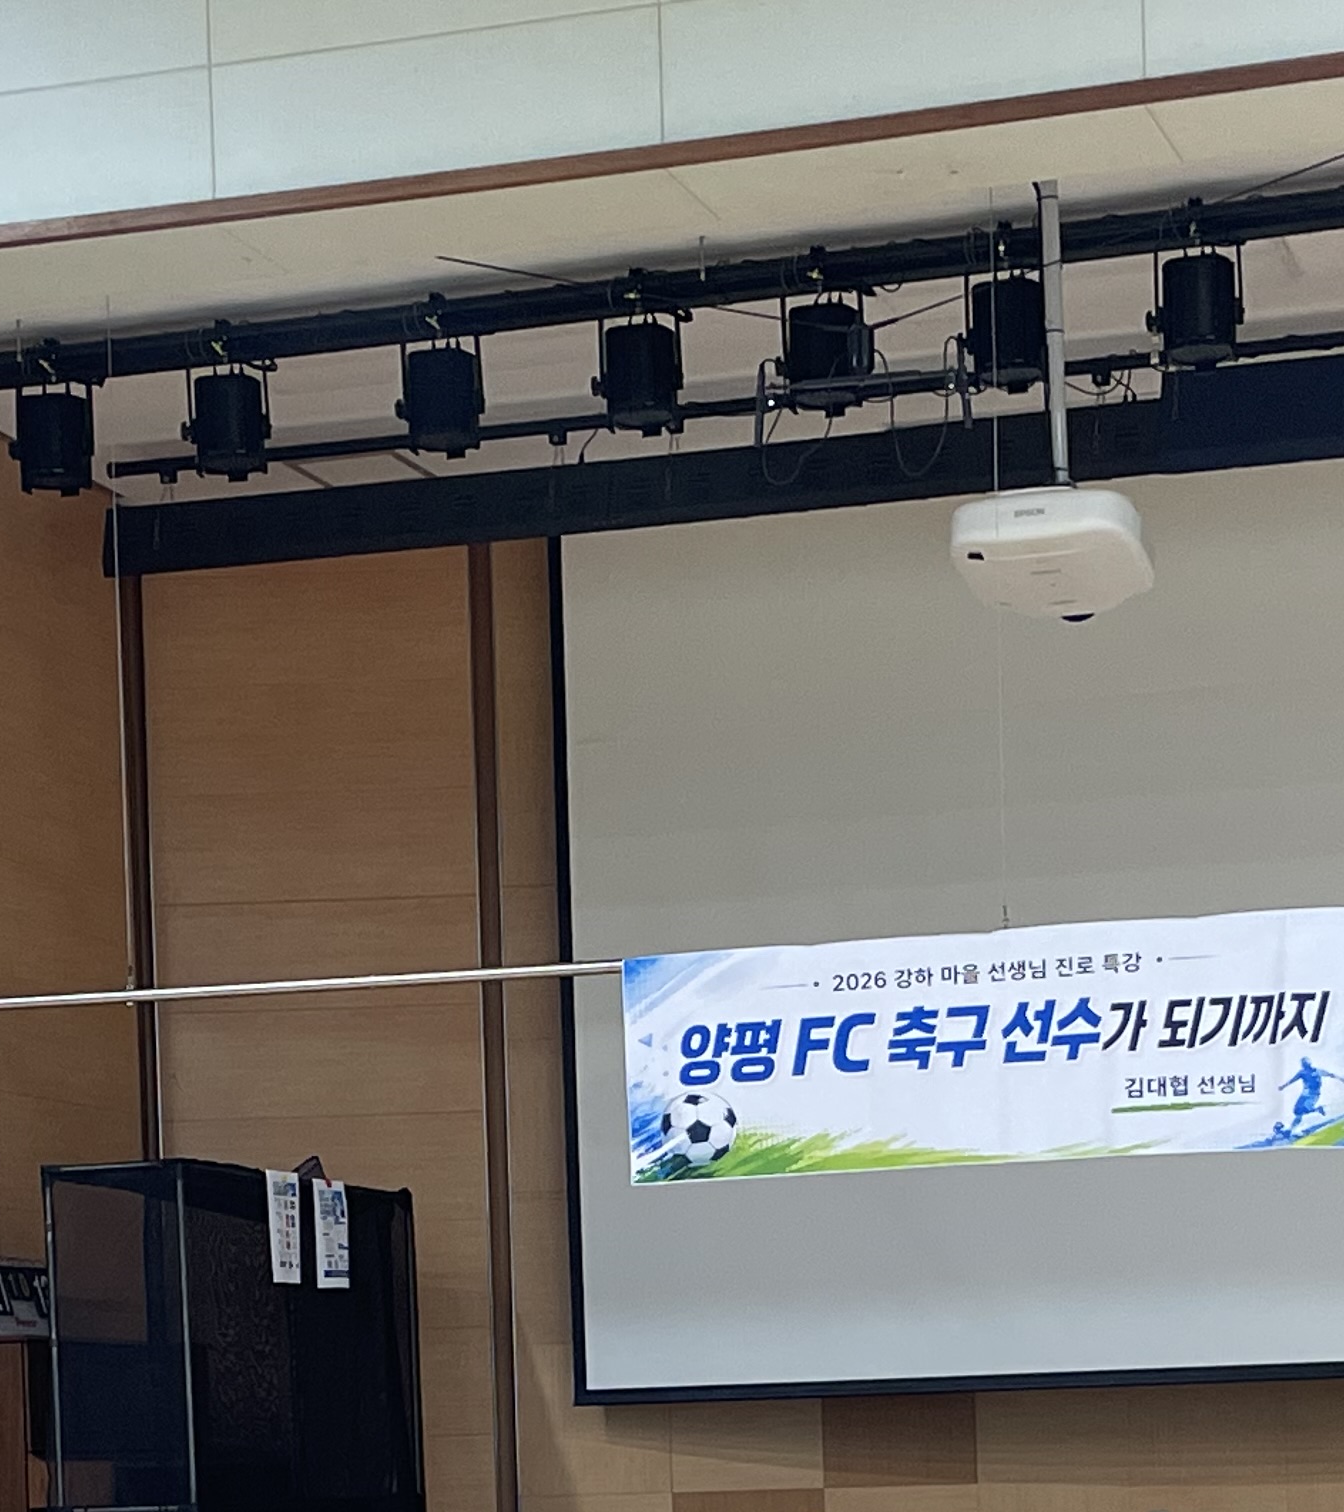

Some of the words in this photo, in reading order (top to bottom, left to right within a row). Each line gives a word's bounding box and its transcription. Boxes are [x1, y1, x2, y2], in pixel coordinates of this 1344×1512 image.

[832, 970, 887, 992] 2026
[893, 967, 933, 989] 강하
[940, 963, 981, 985] 마을
[987, 960, 1047, 982] 선생님
[1054, 955, 1095, 978] 진로
[1102, 952, 1142, 974] 특강
[679, 1018, 782, 1086] 양평
[791, 1012, 876, 1077] FC
[887, 1005, 991, 1070] 축구
[1001, 997, 1149, 1064] 선수가
[1157, 991, 1331, 1049] 되기까지
[1124, 1076, 1189, 1098] 김대협
[1196, 1074, 1256, 1095] 선생님
